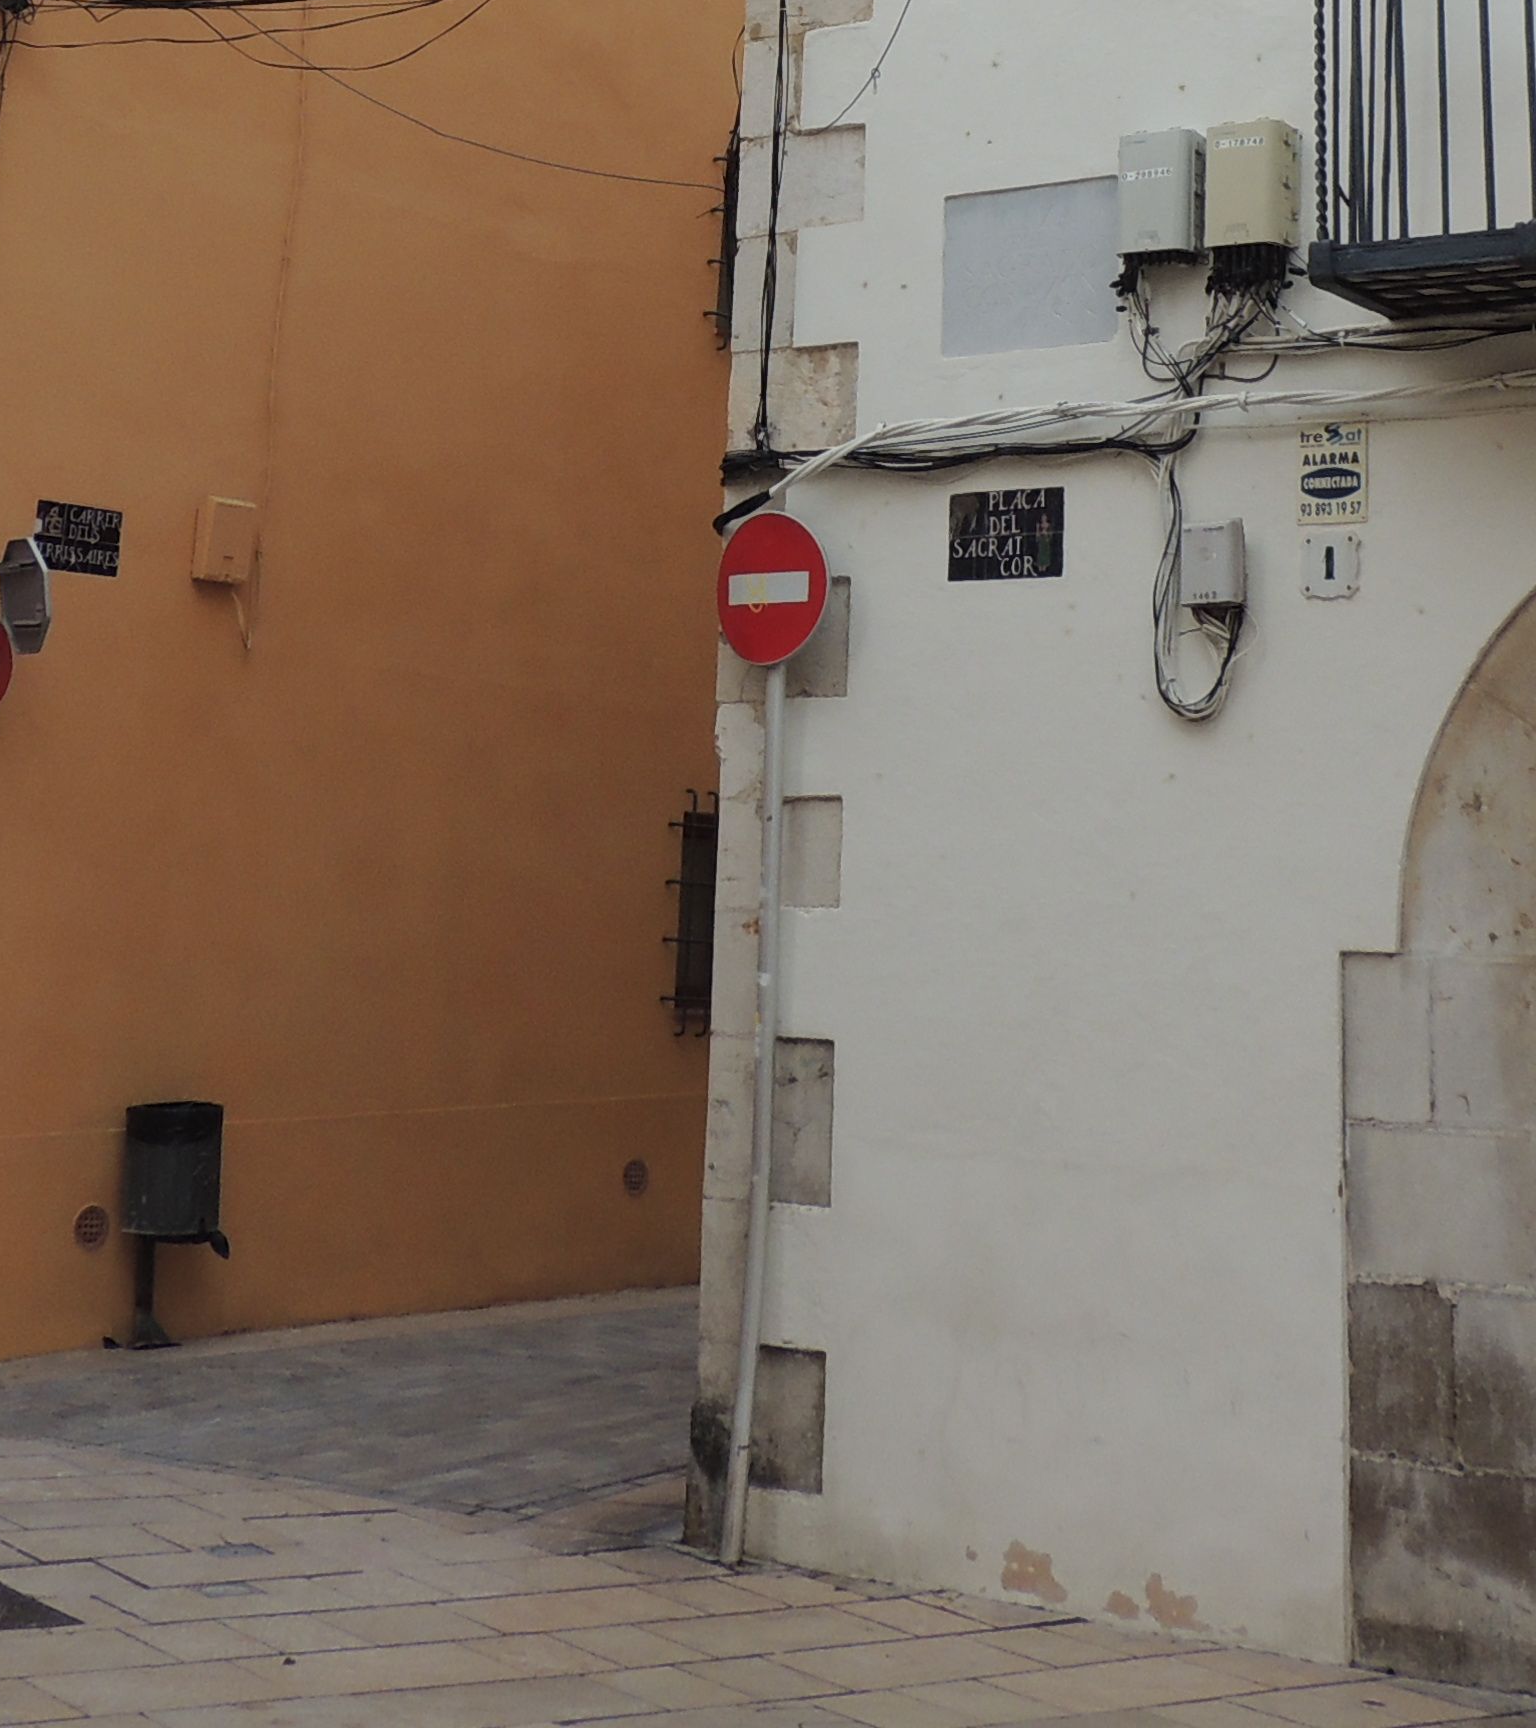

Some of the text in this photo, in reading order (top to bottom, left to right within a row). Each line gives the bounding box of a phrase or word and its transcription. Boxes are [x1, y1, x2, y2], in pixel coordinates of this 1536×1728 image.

[1303, 451, 1359, 466] ALARMA
[1303, 475, 1359, 490] CONNECTADA
[69, 506, 121, 530] CARRER
[1300, 500, 1362, 517] 93 893 19 57
[68, 524, 100, 544] DELS
[952, 536, 1023, 560] SACRAT
[1000, 555, 1037, 577] COR
[1324, 546, 1335, 580] 1
